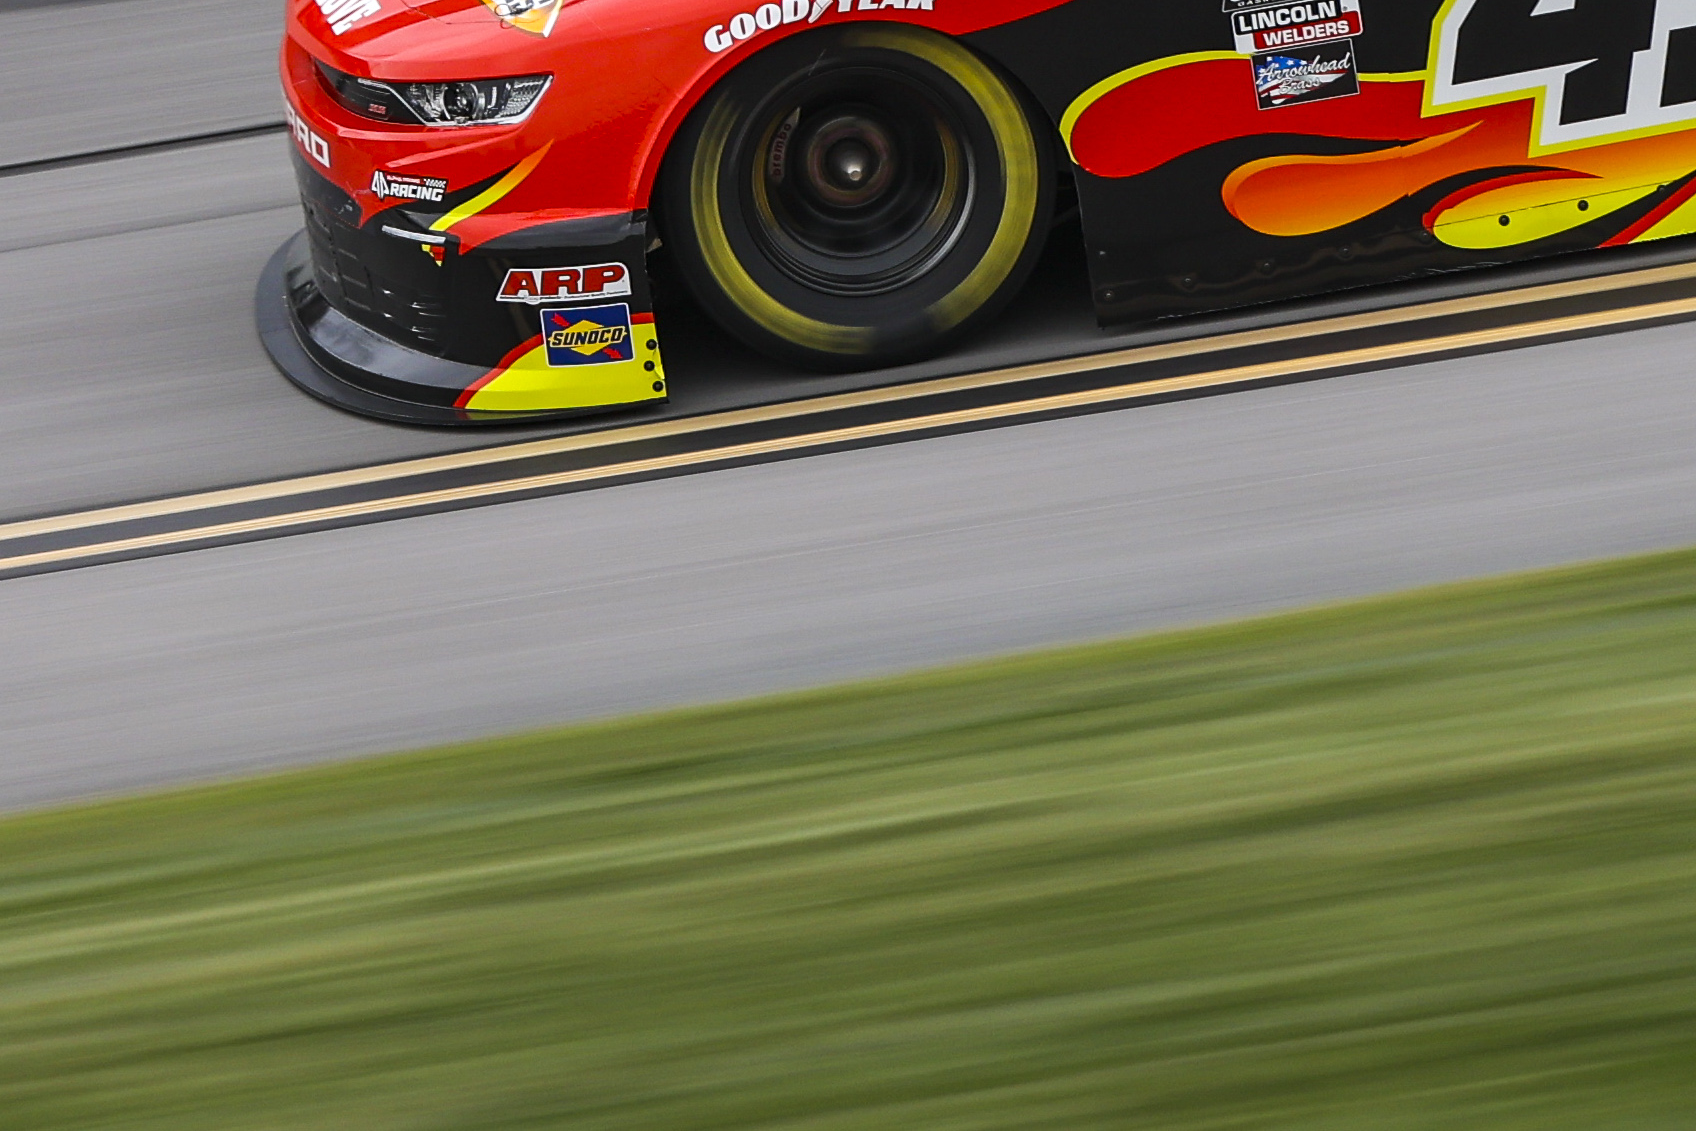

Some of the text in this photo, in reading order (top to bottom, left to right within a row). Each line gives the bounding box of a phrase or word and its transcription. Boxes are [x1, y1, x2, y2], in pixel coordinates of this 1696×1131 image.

[1238, 0, 1337, 32] LINCOLN
[1262, 19, 1350, 46] WELDERS
[1256, 51, 1351, 83] Arrowhead
[389, 182, 445, 202] RACING
[500, 264, 626, 297] ARP
[551, 327, 624, 346] SUNOCO
